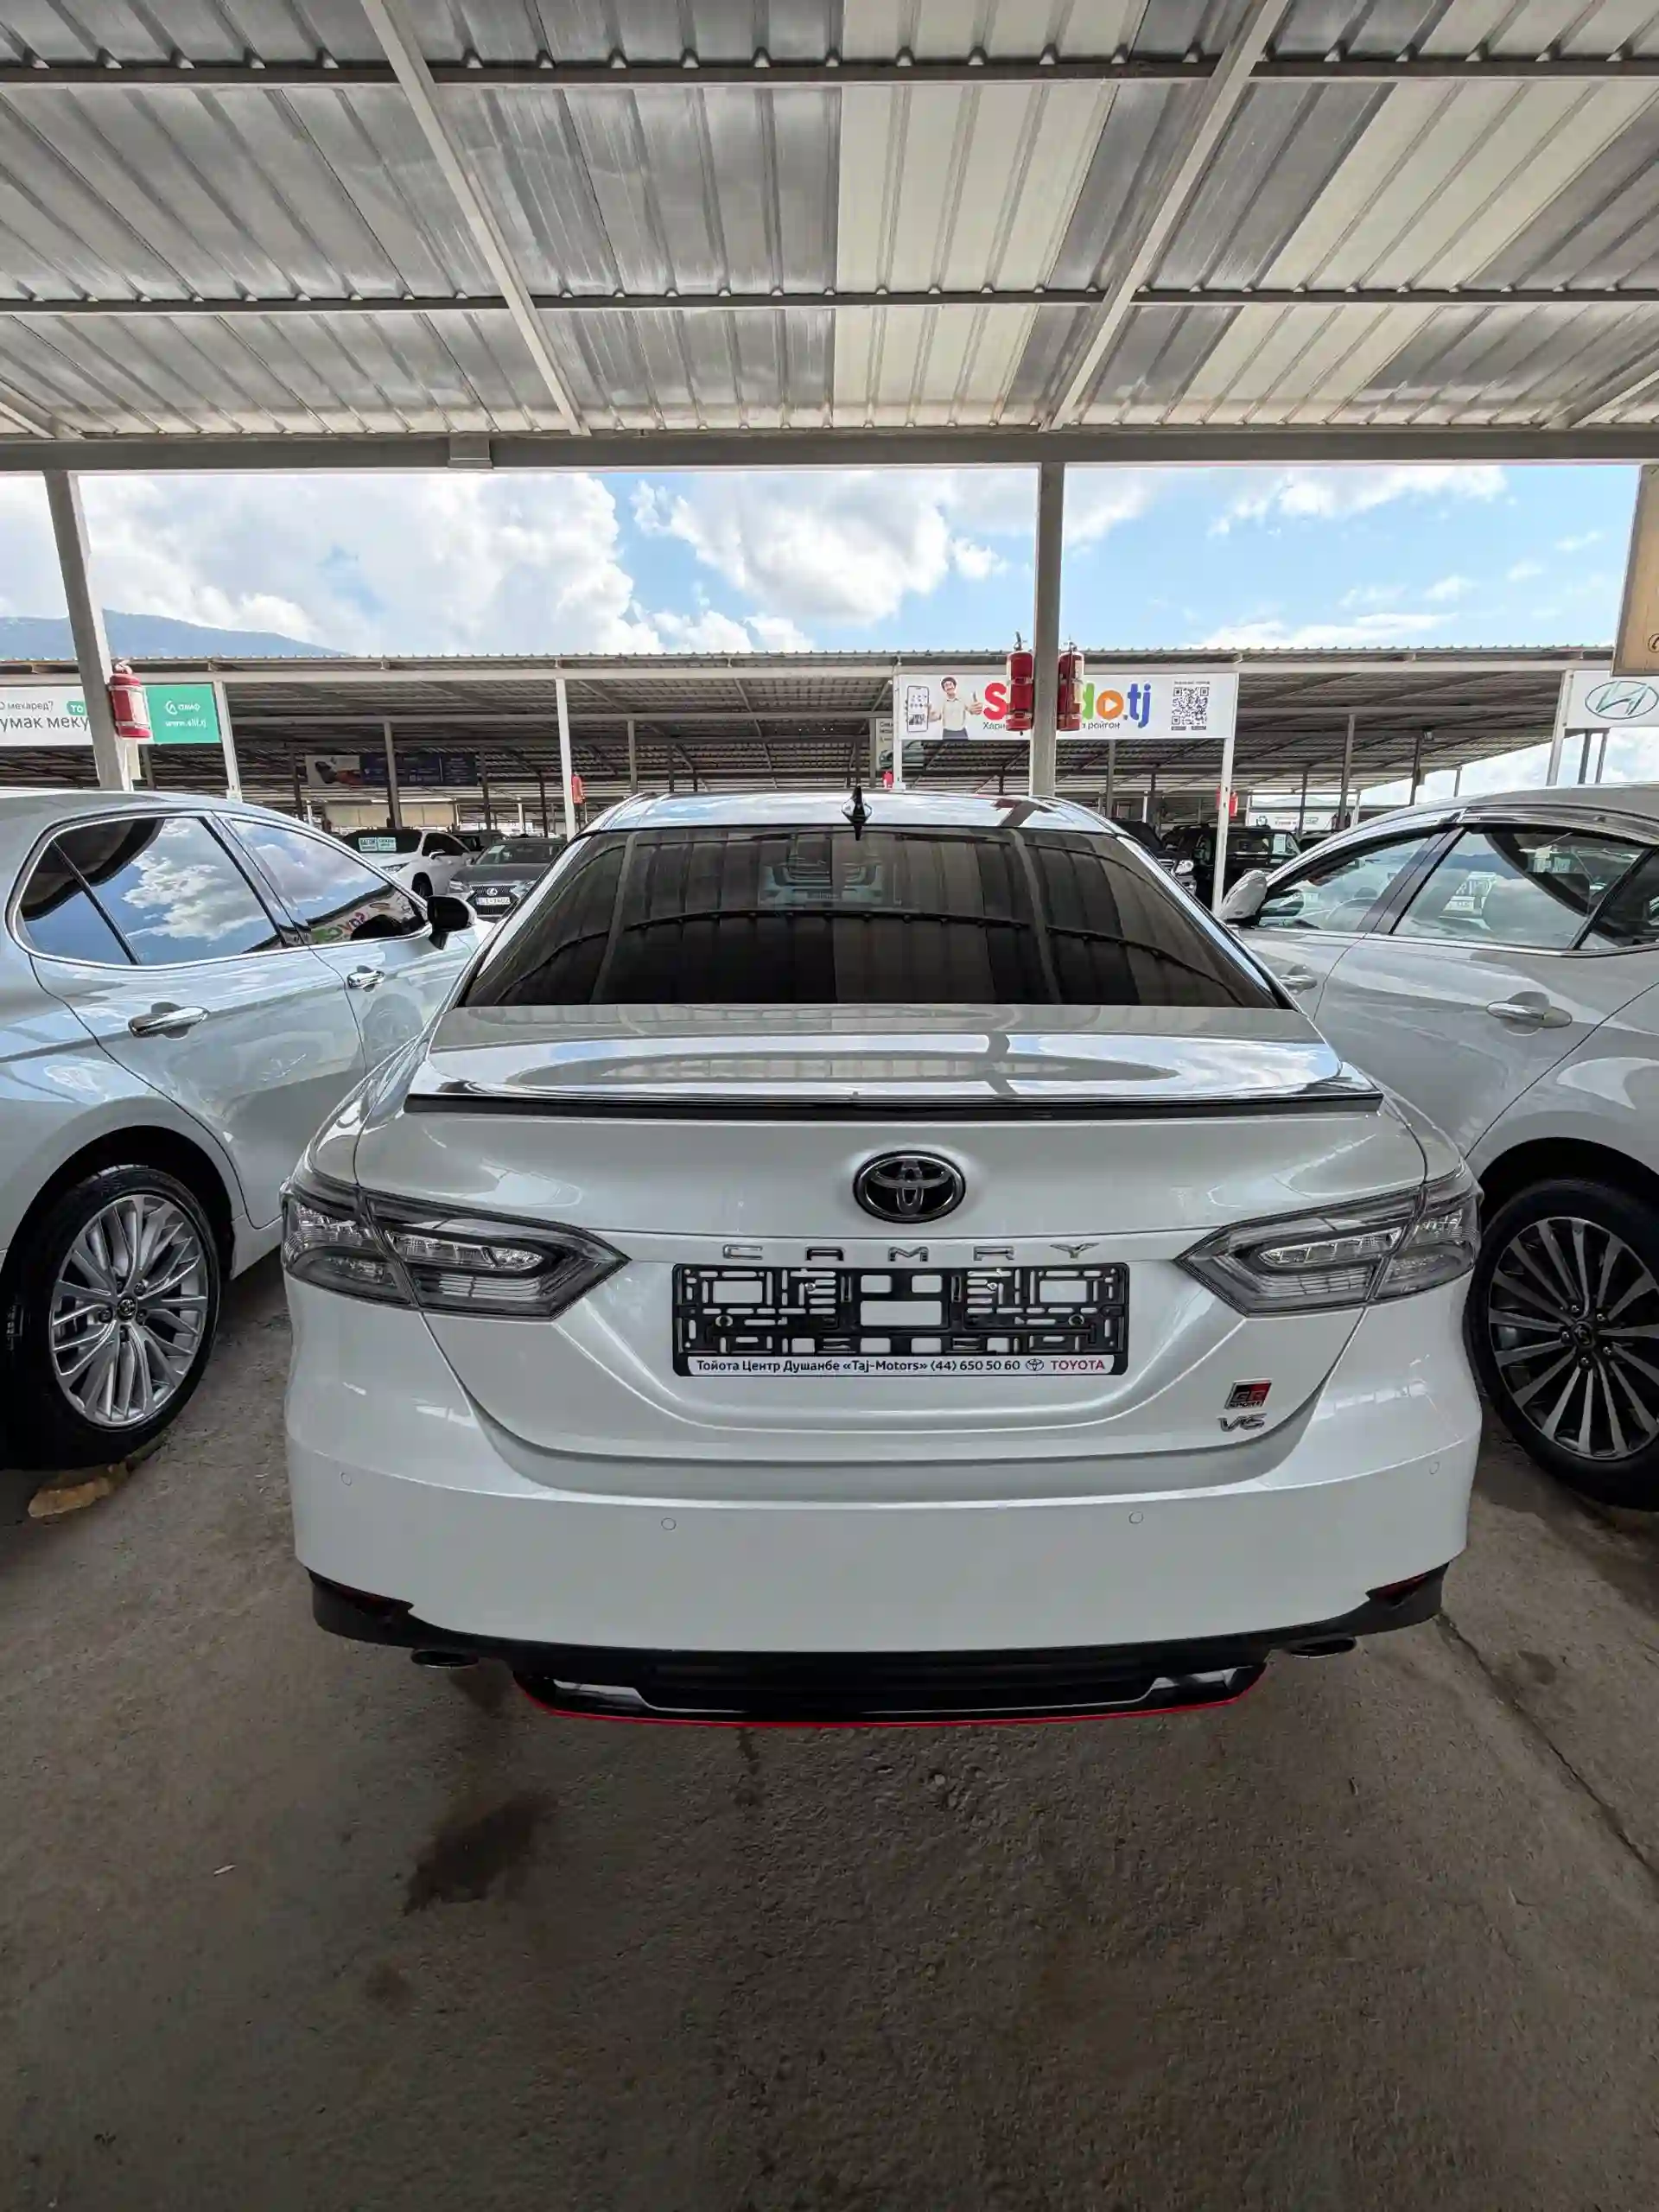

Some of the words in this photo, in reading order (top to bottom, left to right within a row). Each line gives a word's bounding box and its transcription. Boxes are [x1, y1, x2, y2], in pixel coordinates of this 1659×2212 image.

[721, 1242, 1100, 1262] CAMRY
[696, 1359, 740, 1371] Тойота
[742, 1360, 781, 1374] Центр
[783, 1359, 840, 1374] Душанбе
[842, 1359, 927, 1373] «Taj-Motors»
[930, 1359, 957, 1372] (44)
[959, 1359, 984, 1371] 650
[985, 1359, 1002, 1371] 50
[1004, 1359, 1021, 1371] 60
[1050, 1359, 1106, 1371] TOYOTA
